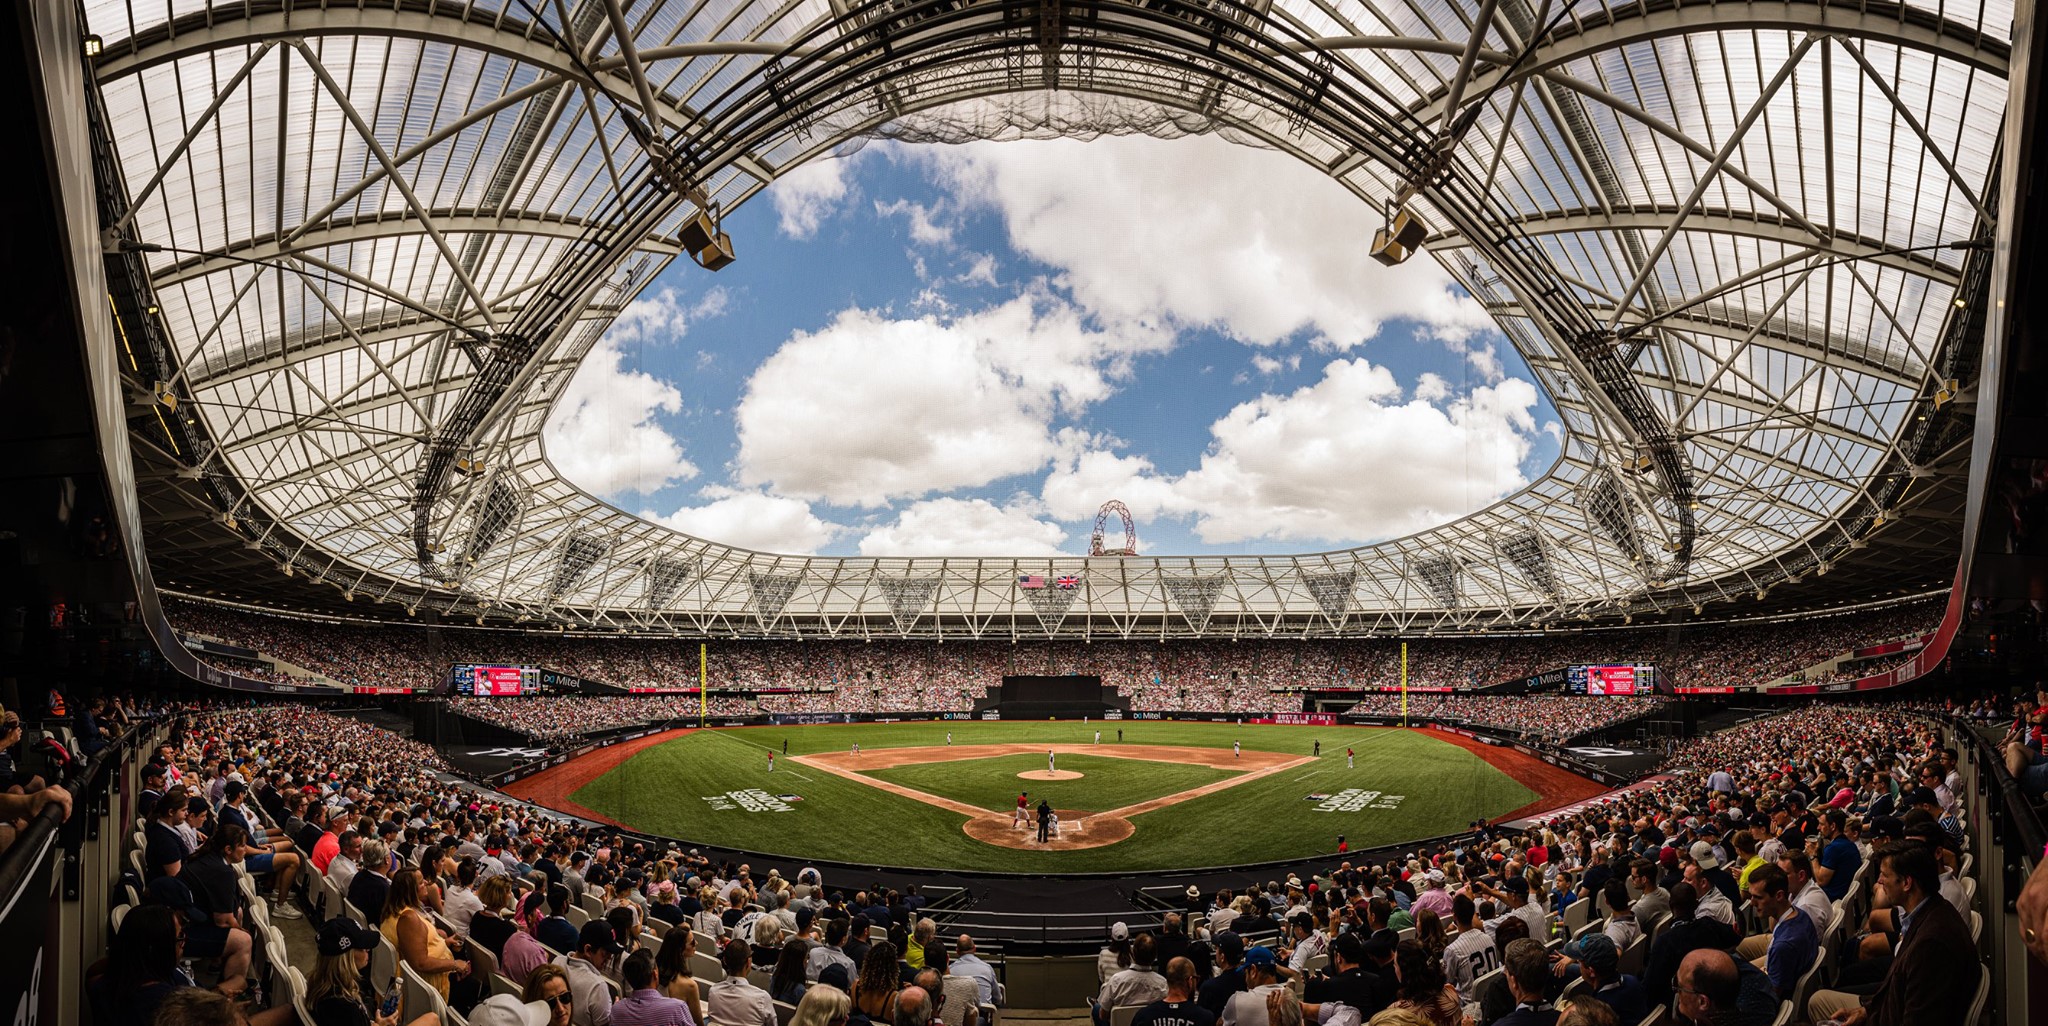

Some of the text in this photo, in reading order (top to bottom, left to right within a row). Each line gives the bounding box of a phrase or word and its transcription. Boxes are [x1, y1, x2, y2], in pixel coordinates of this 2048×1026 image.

[556, 675, 580, 688] Mitel
[1539, 671, 1565, 685] Mitel
[953, 712, 971, 720] Mitel
[1143, 712, 1161, 720] Mitel
[725, 790, 770, 813] SERIES
[743, 788, 796, 812] LONDON
[1311, 788, 1366, 812] LONDON
[1338, 790, 1382, 812] SERIES
[743, 921, 754, 939] 7
[338, 936, 352, 951] 99
[1469, 945, 1497, 981] 20
